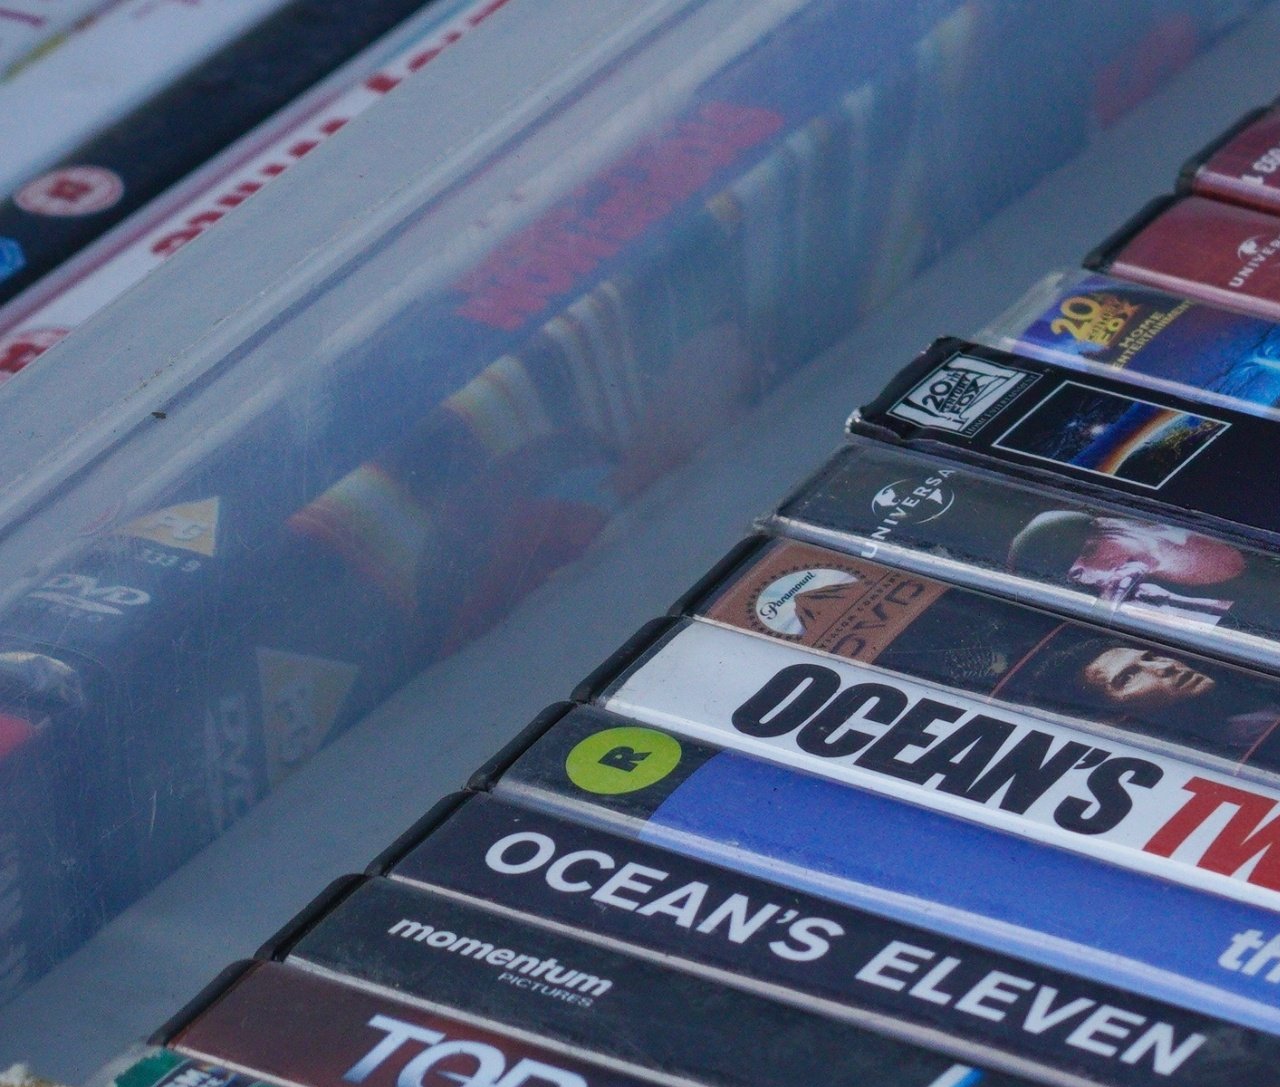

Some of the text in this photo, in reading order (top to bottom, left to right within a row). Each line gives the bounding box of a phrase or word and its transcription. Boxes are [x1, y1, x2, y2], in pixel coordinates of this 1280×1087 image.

[759, 571, 817, 621] Paramount
[597, 744, 653, 772] R
[730, 662, 1165, 836] OCEAN'S
[388, 918, 614, 997] momentum
[483, 831, 1206, 1077] OCEAN'S ELEVEN
